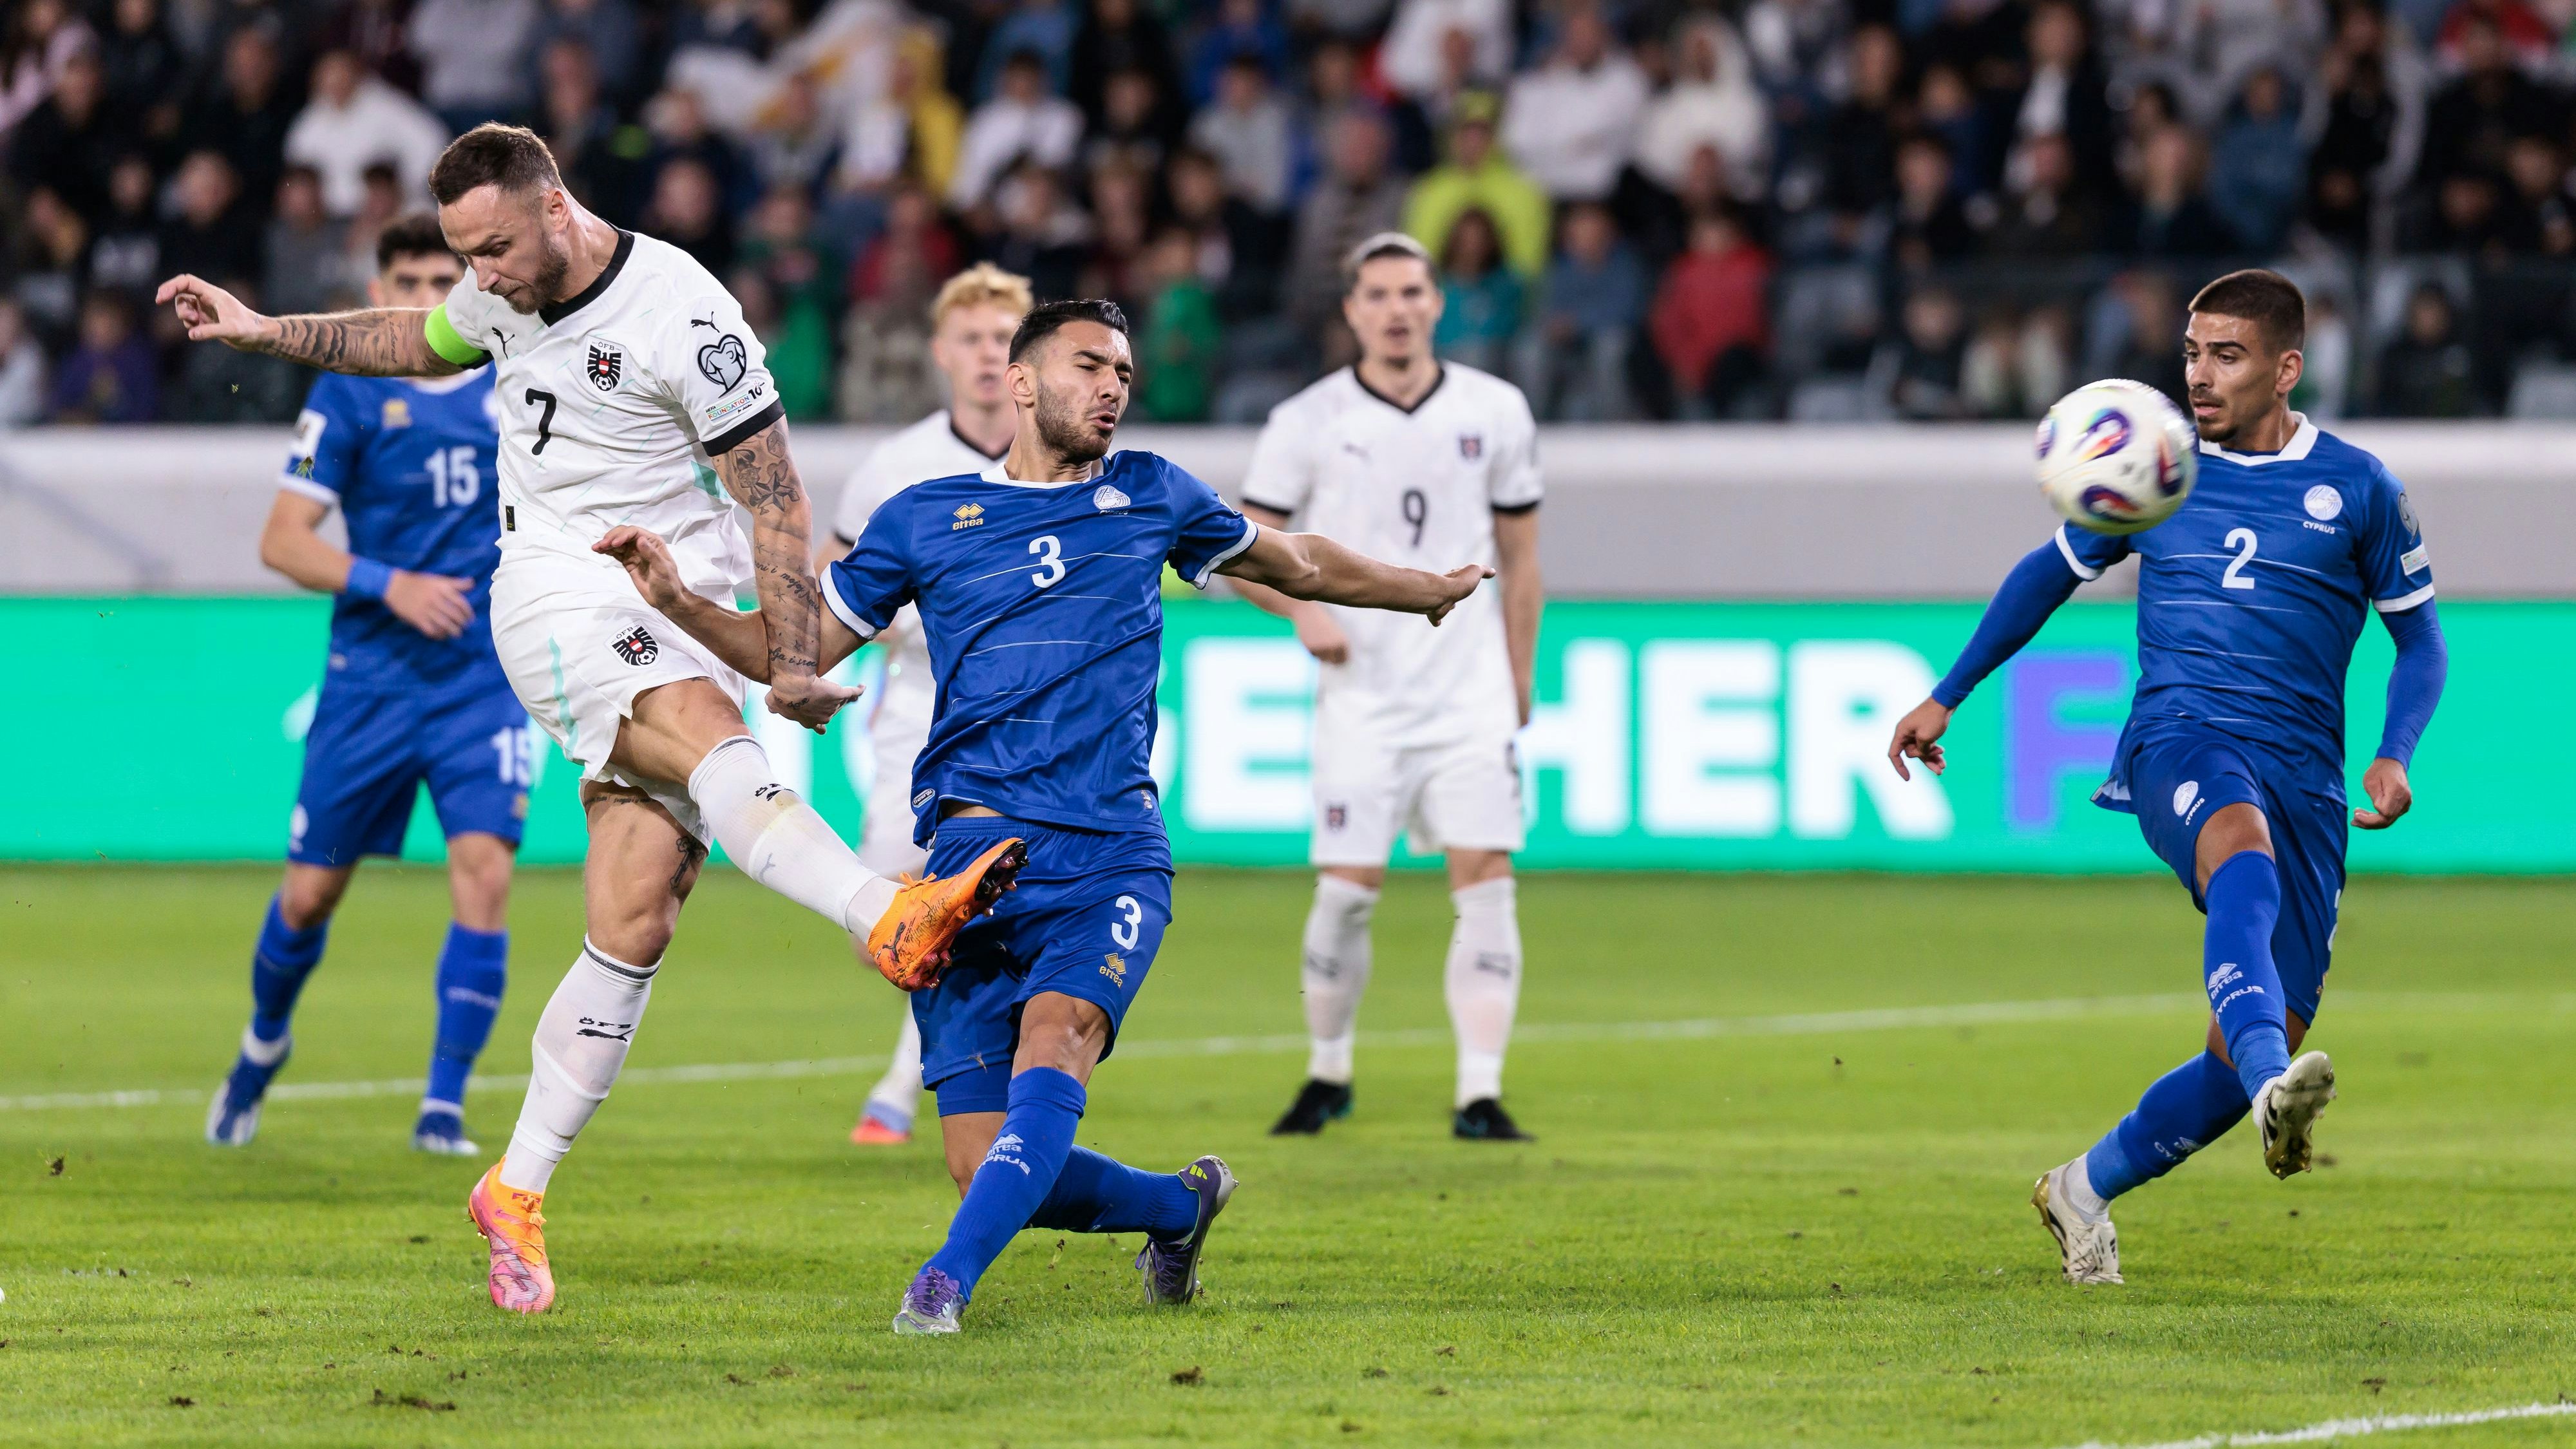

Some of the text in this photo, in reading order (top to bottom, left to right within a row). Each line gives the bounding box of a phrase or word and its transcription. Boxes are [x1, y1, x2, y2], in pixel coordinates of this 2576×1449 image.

[525, 388, 557, 455] 7
[707, 395, 750, 420] FOUNDATION
[424, 446, 480, 509] 15
[952, 517, 984, 531] errea
[1402, 489, 1427, 547] 9
[2302, 520, 2336, 535] CYPRUS
[1028, 535, 1066, 589] 3
[2221, 527, 2259, 590] 2
[2185, 797, 2205, 826] CYPRUS
[1111, 895, 1142, 950] 3
[1099, 965, 1123, 989] errea
